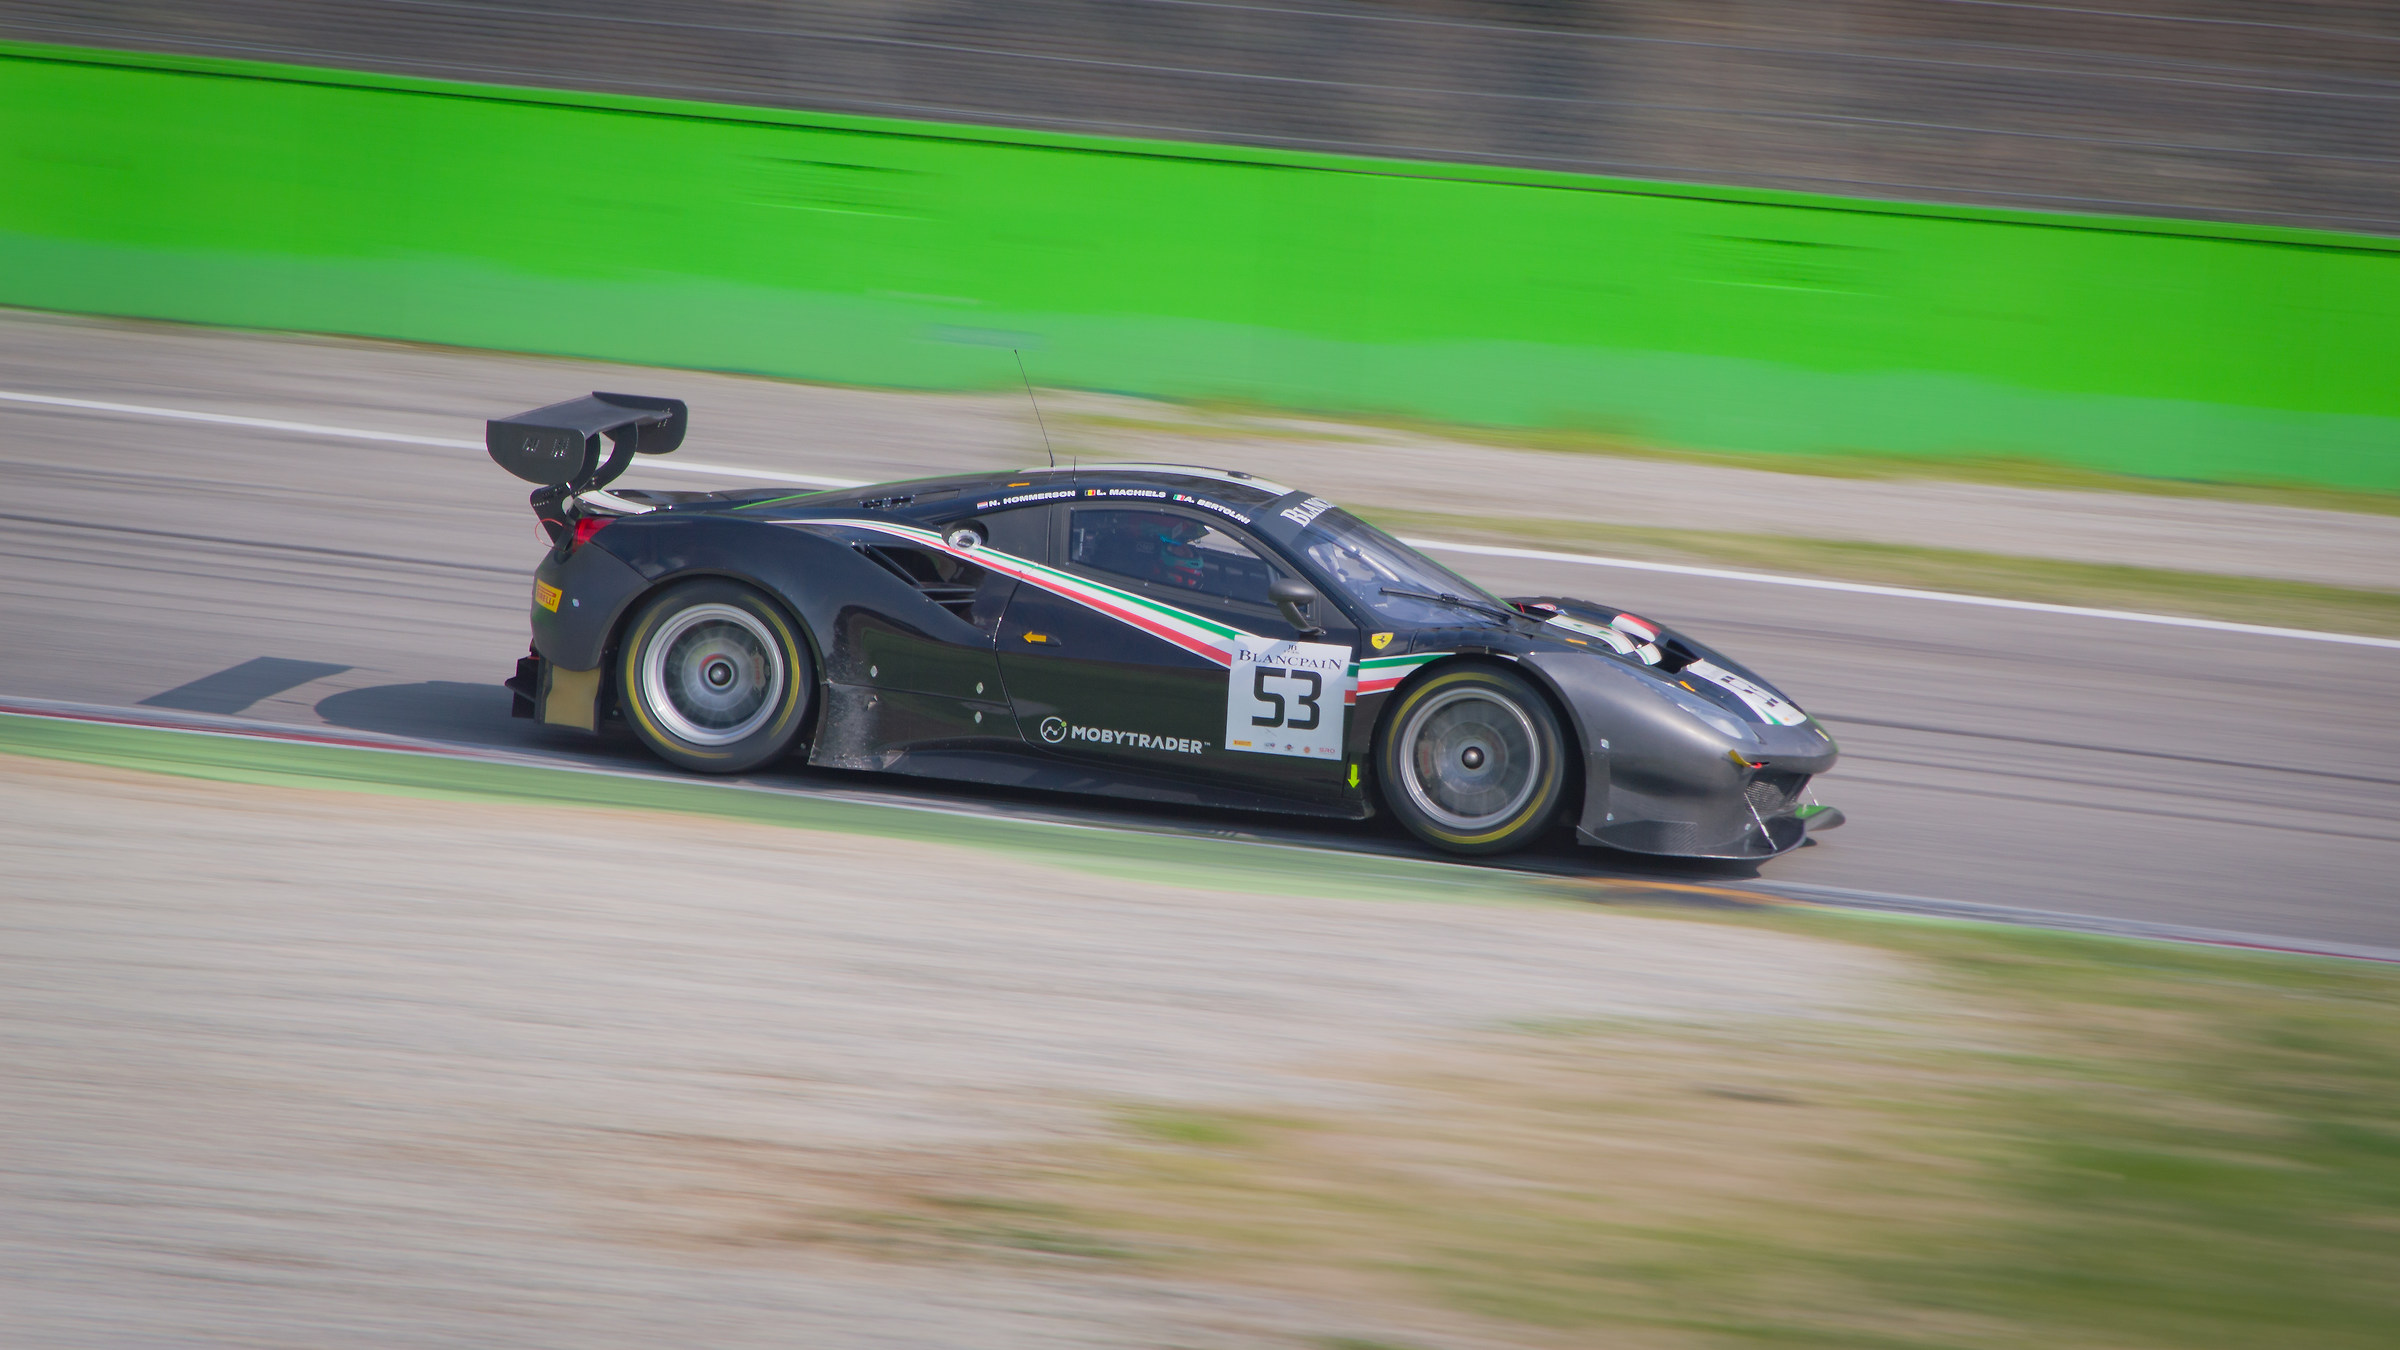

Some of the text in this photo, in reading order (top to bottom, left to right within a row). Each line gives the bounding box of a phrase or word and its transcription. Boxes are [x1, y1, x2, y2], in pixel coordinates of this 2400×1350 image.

[1003, 490, 1076, 505] HOMMERSON
[1109, 489, 1167, 498] MACHIELS
[1183, 496, 1251, 525] A. BERTOLINI
[1239, 649, 1342, 670] BLANCPAIN
[1251, 665, 1322, 731] 53
